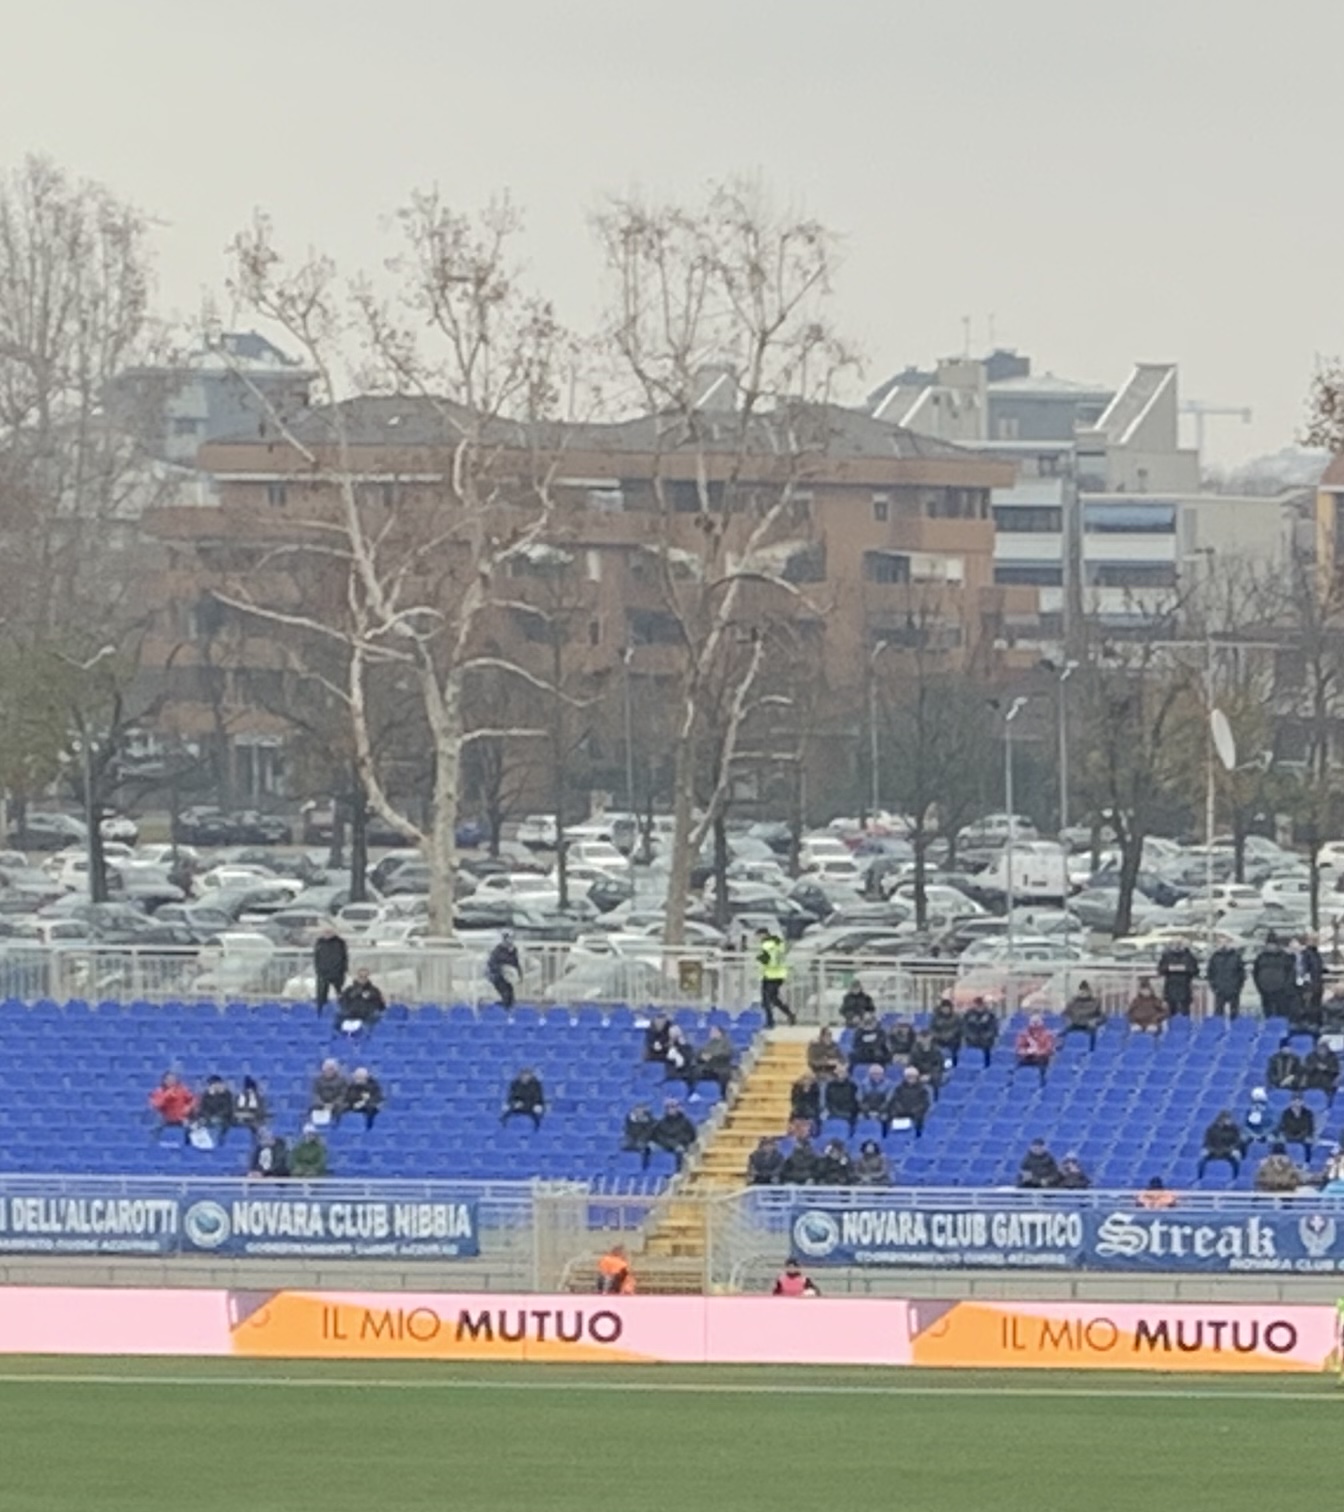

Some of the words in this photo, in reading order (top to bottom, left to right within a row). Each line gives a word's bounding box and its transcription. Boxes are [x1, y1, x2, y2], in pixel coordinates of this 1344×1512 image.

[11, 1198, 178, 1234] DELL'ALCAROTTI
[233, 1201, 325, 1236] NOVARA
[329, 1203, 389, 1238] CLUB
[842, 1211, 927, 1246] NOVARA
[931, 1213, 987, 1247] CLUB
[992, 1212, 1083, 1248] GATTICO
[1095, 1212, 1276, 1258] Streak
[1295, 1258, 1334, 1271] CLUB
[322, 1306, 348, 1340] IL
[359, 1307, 441, 1341] MIO
[455, 1309, 623, 1343] MUTUO
[1001, 1316, 1026, 1349] IL
[1038, 1317, 1119, 1352] MIO
[1133, 1319, 1298, 1353] MUTUO
